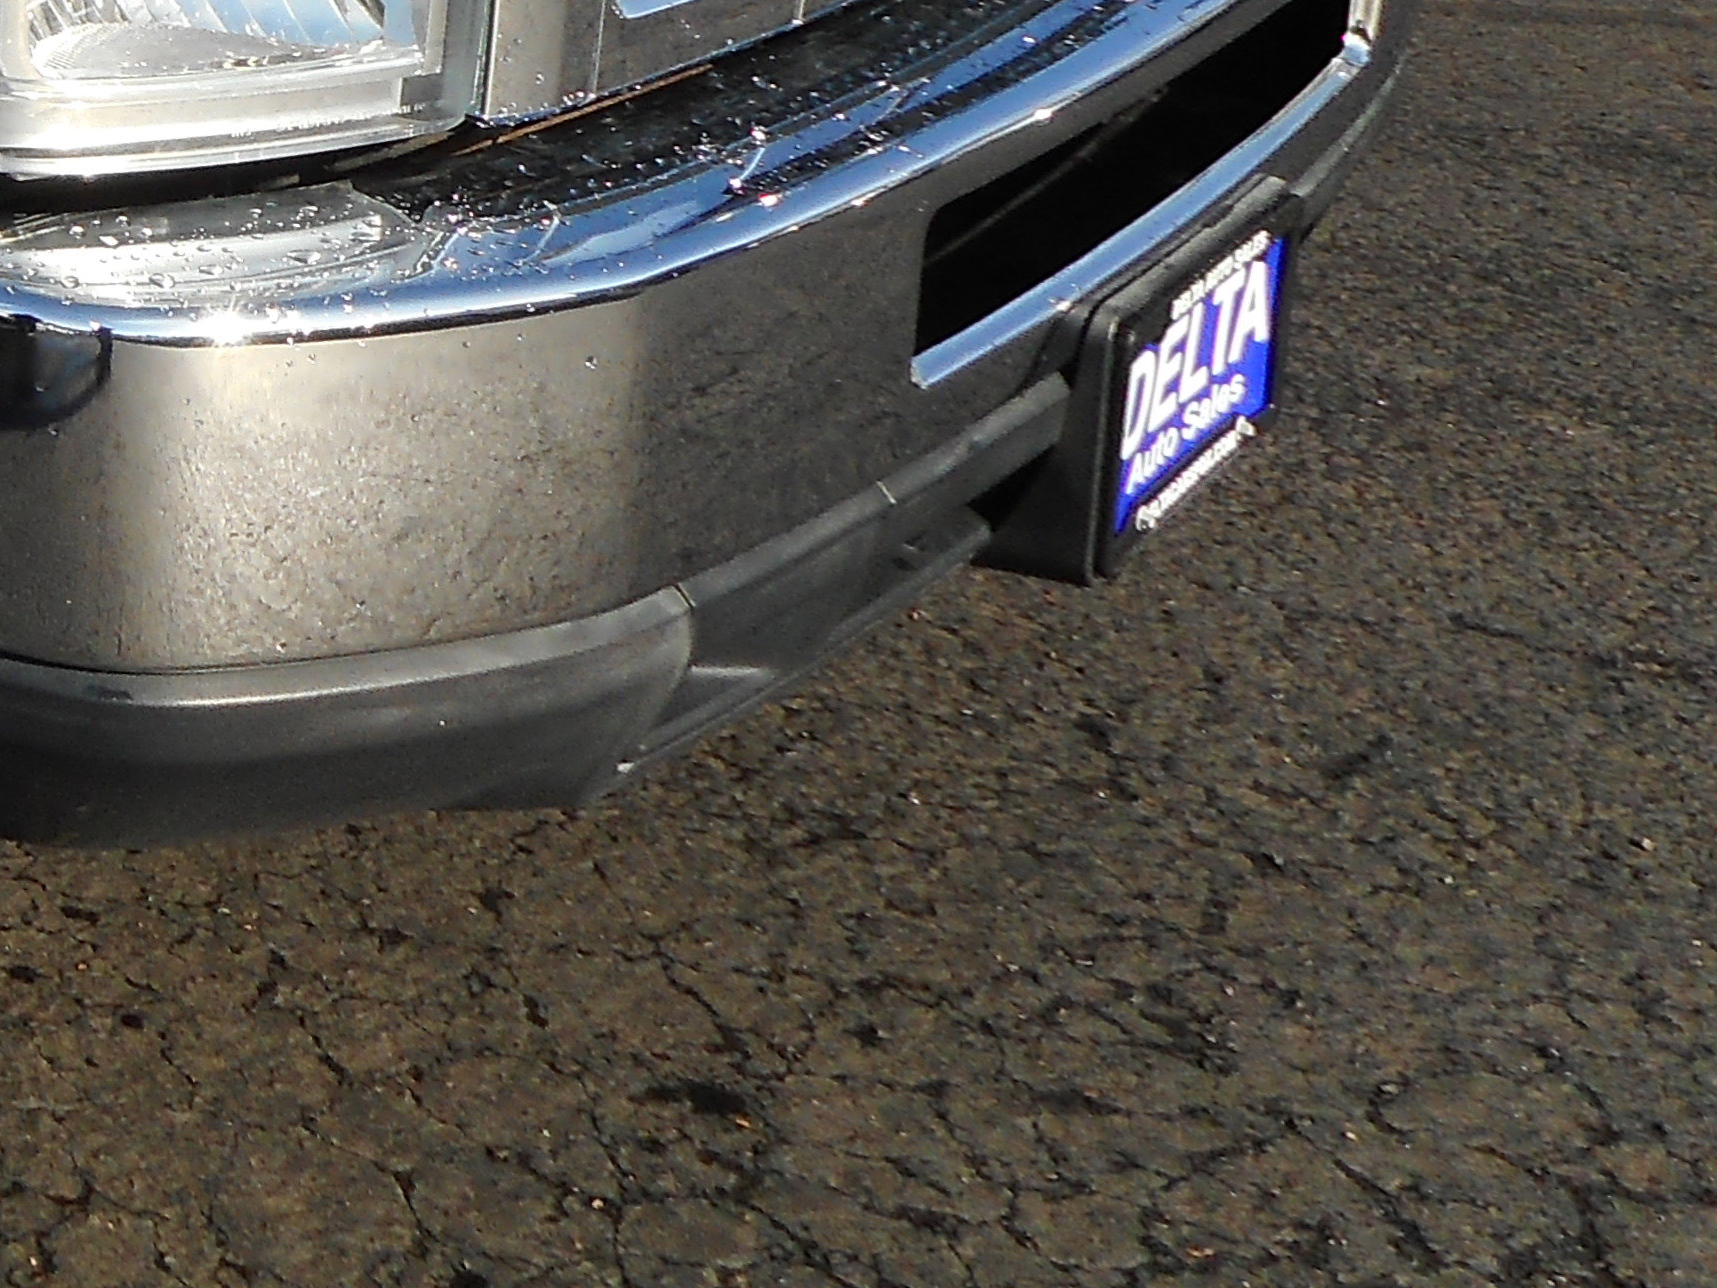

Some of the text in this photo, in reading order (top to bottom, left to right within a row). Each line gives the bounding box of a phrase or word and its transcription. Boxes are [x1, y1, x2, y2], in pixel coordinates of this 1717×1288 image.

[1120, 259, 1271, 461] DELTA
[1124, 426, 1181, 496] Auto
[1182, 373, 1247, 442] Sales
